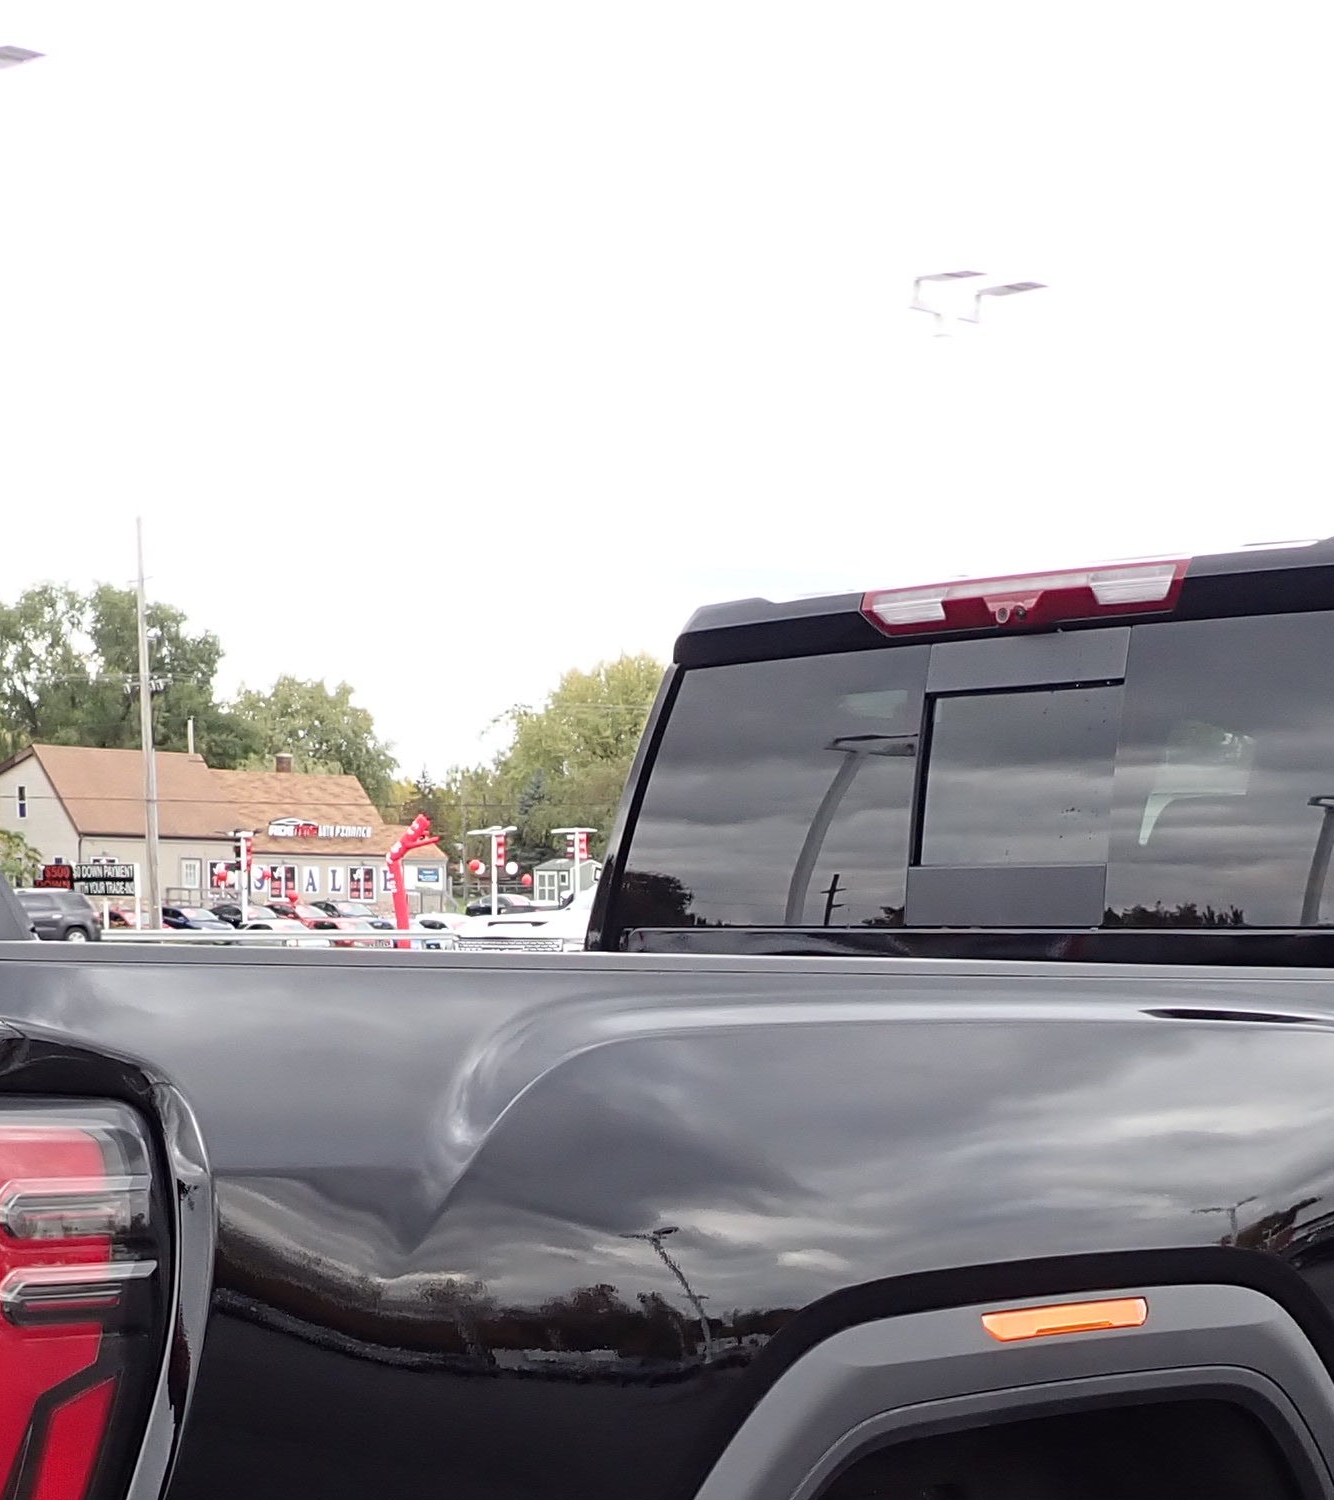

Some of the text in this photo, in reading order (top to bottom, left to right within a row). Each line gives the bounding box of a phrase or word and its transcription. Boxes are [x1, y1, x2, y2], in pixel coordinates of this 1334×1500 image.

[82, 865, 103, 878] DOWN
[103, 865, 133, 878] PAYMENT
[90, 882, 105, 894] YOUR
